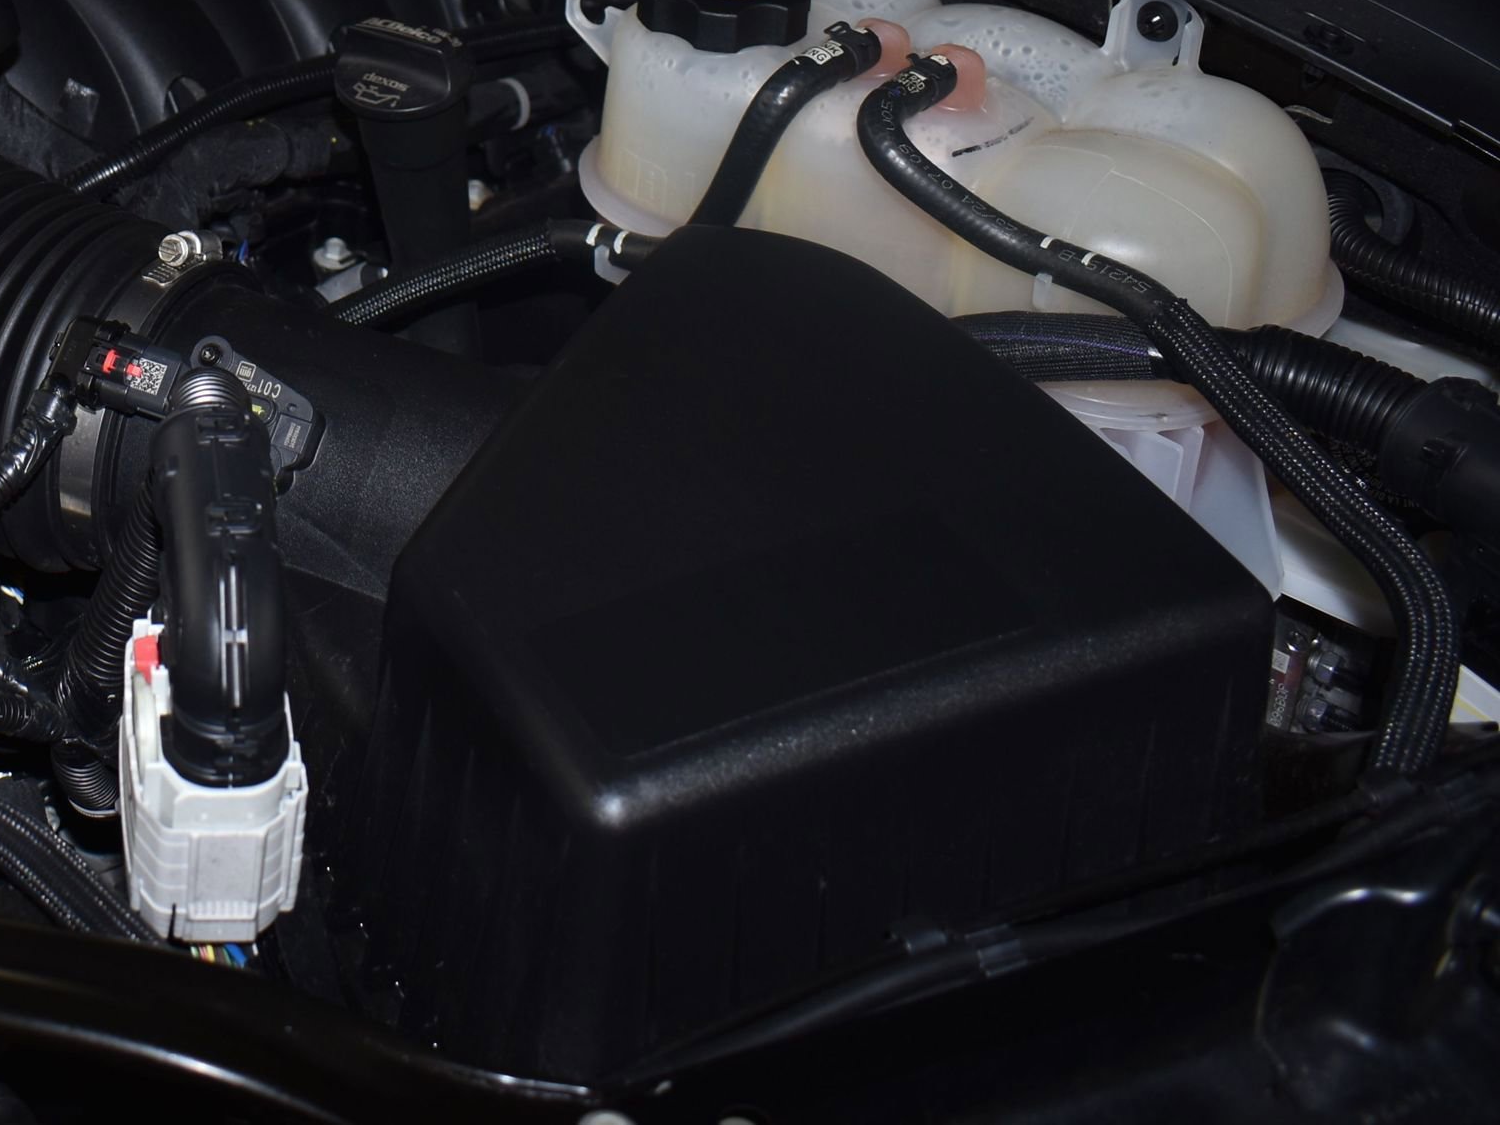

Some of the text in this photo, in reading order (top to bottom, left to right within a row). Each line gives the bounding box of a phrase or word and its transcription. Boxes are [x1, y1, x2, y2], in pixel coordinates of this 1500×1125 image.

[358, 17, 442, 44] ACDelco
[362, 72, 410, 92] dexos
[257, 379, 281, 398] C01
